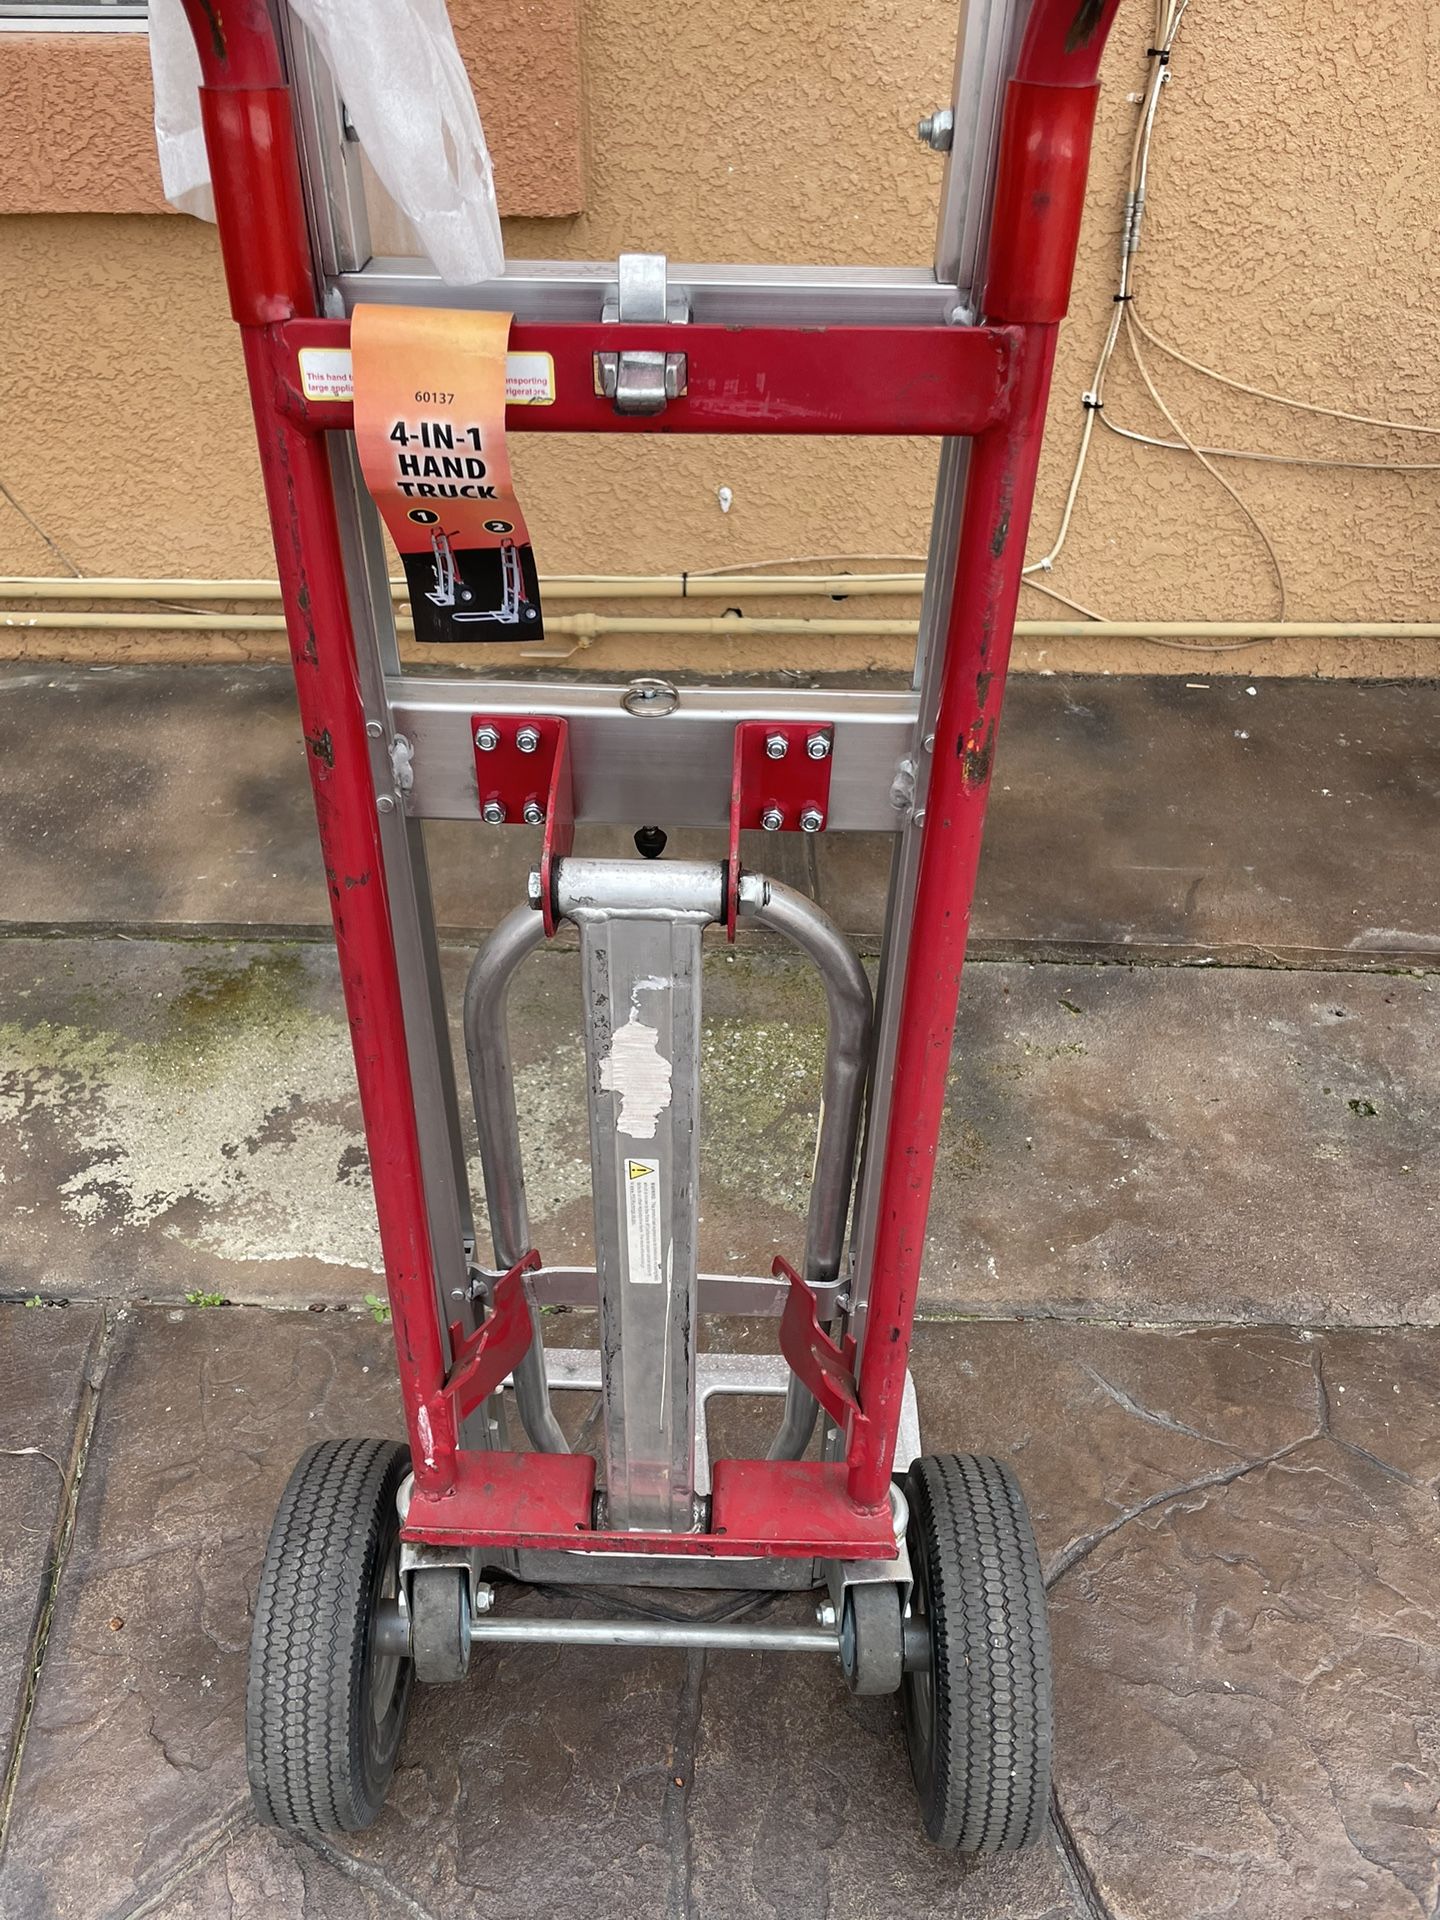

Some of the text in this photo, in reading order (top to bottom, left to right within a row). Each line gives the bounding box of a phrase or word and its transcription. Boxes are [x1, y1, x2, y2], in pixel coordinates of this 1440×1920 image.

[326, 373, 347, 381] hand
[506, 377, 548, 387] nsporting
[308, 384, 329, 393] large
[506, 387, 549, 397] rigerators.
[415, 391, 455, 405] 60137
[390, 421, 482, 451] 4-IN-1
[398, 454, 486, 479] HAND
[397, 482, 498, 499] TRUCK
[417, 512, 428, 521] 1
[492, 523, 505, 531] 2
